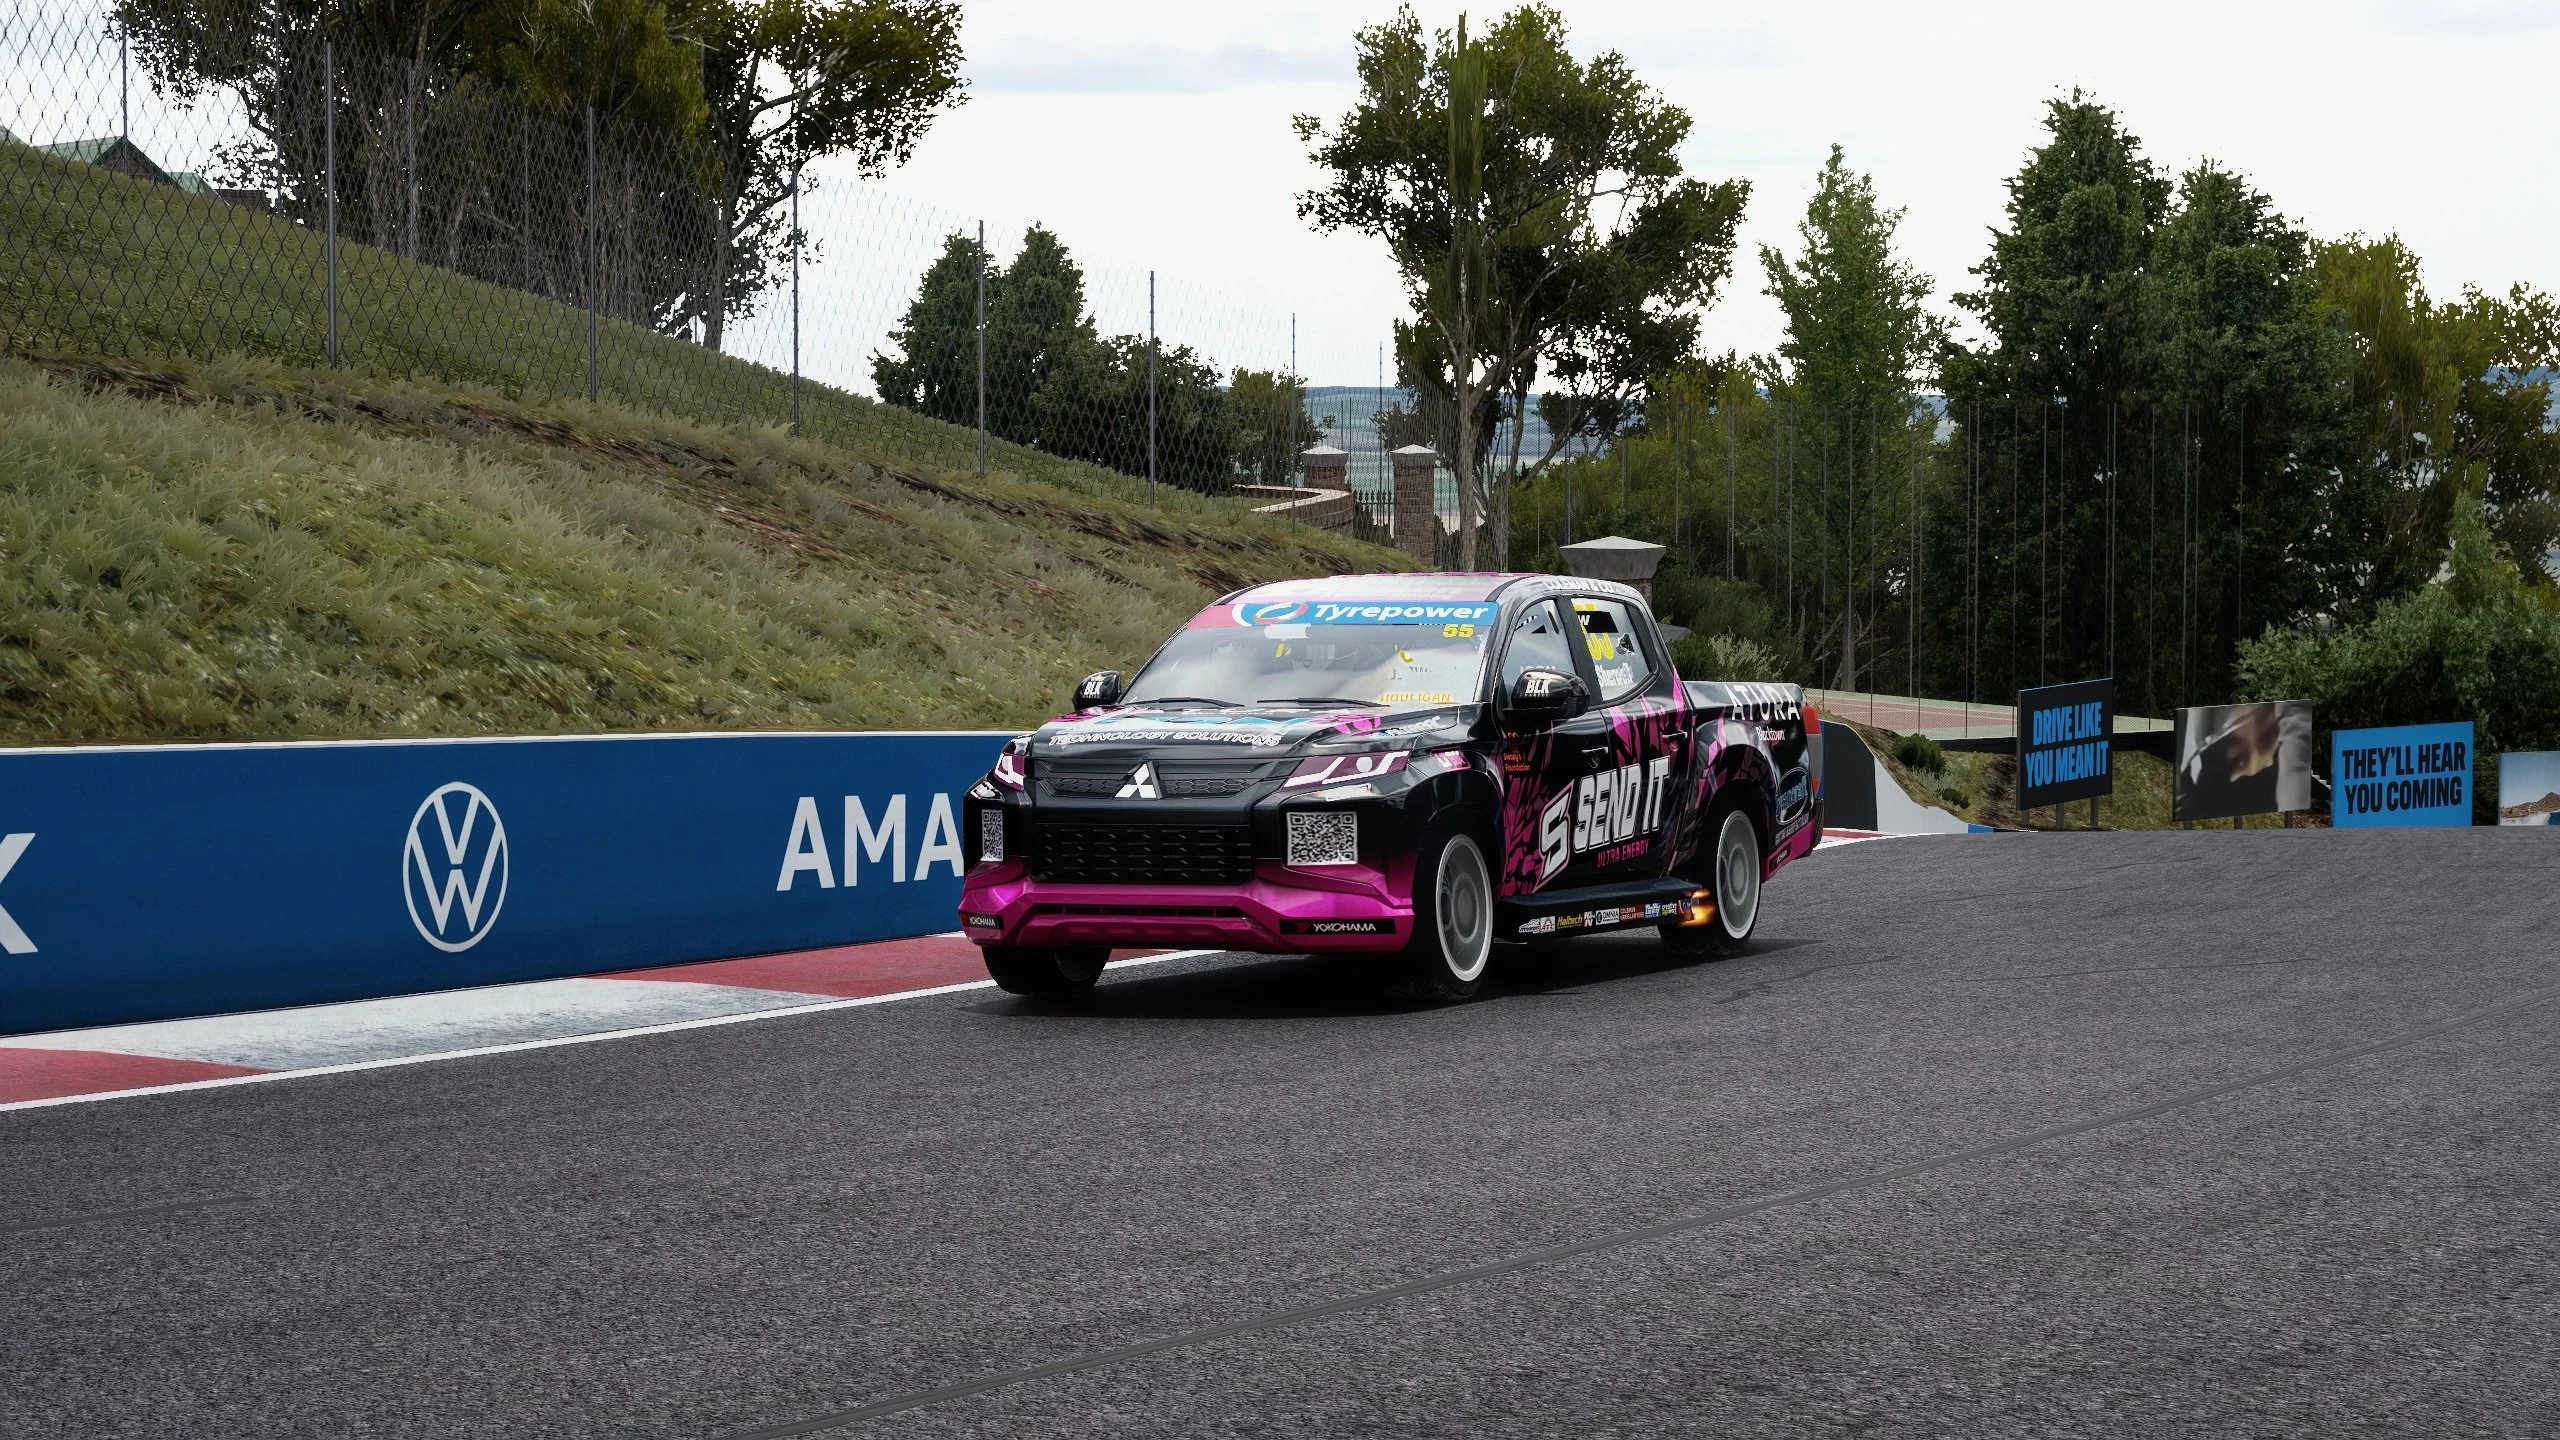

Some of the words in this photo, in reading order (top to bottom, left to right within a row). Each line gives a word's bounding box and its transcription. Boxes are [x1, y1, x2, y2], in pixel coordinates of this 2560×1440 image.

[1314, 604, 1488, 621] Tyrepower
[1442, 624, 1475, 638] 55
[1525, 679, 1551, 694] BLK
[1724, 684, 1801, 721] ATURA
[2033, 705, 2072, 745] DRIVE
[2074, 701, 2102, 740] LIKE
[1049, 731, 1170, 747] TECHNOLOGY
[1173, 731, 1285, 747] SOLUTIONS
[1504, 763, 1531, 772] Foundation
[2025, 749, 2054, 788] YOU
[2055, 742, 2095, 783] MEAN
[2095, 740, 2109, 776] IT
[2342, 745, 2414, 779] THEY'LL
[2417, 742, 2466, 774] HEAR
[1574, 763, 1641, 853] SEND
[1642, 756, 1670, 834] IT
[2344, 782, 2382, 815] YOU
[2386, 776, 2462, 811] COMING
[776, 792, 964, 892] AMA
[1597, 847, 1620, 867] ULTRA
[1622, 839, 1649, 860] ENERGY
[1557, 913, 1583, 927] Haltech
[1602, 907, 1619, 920] OMNIA
[1313, 922, 1377, 932] YOKOHAMA
